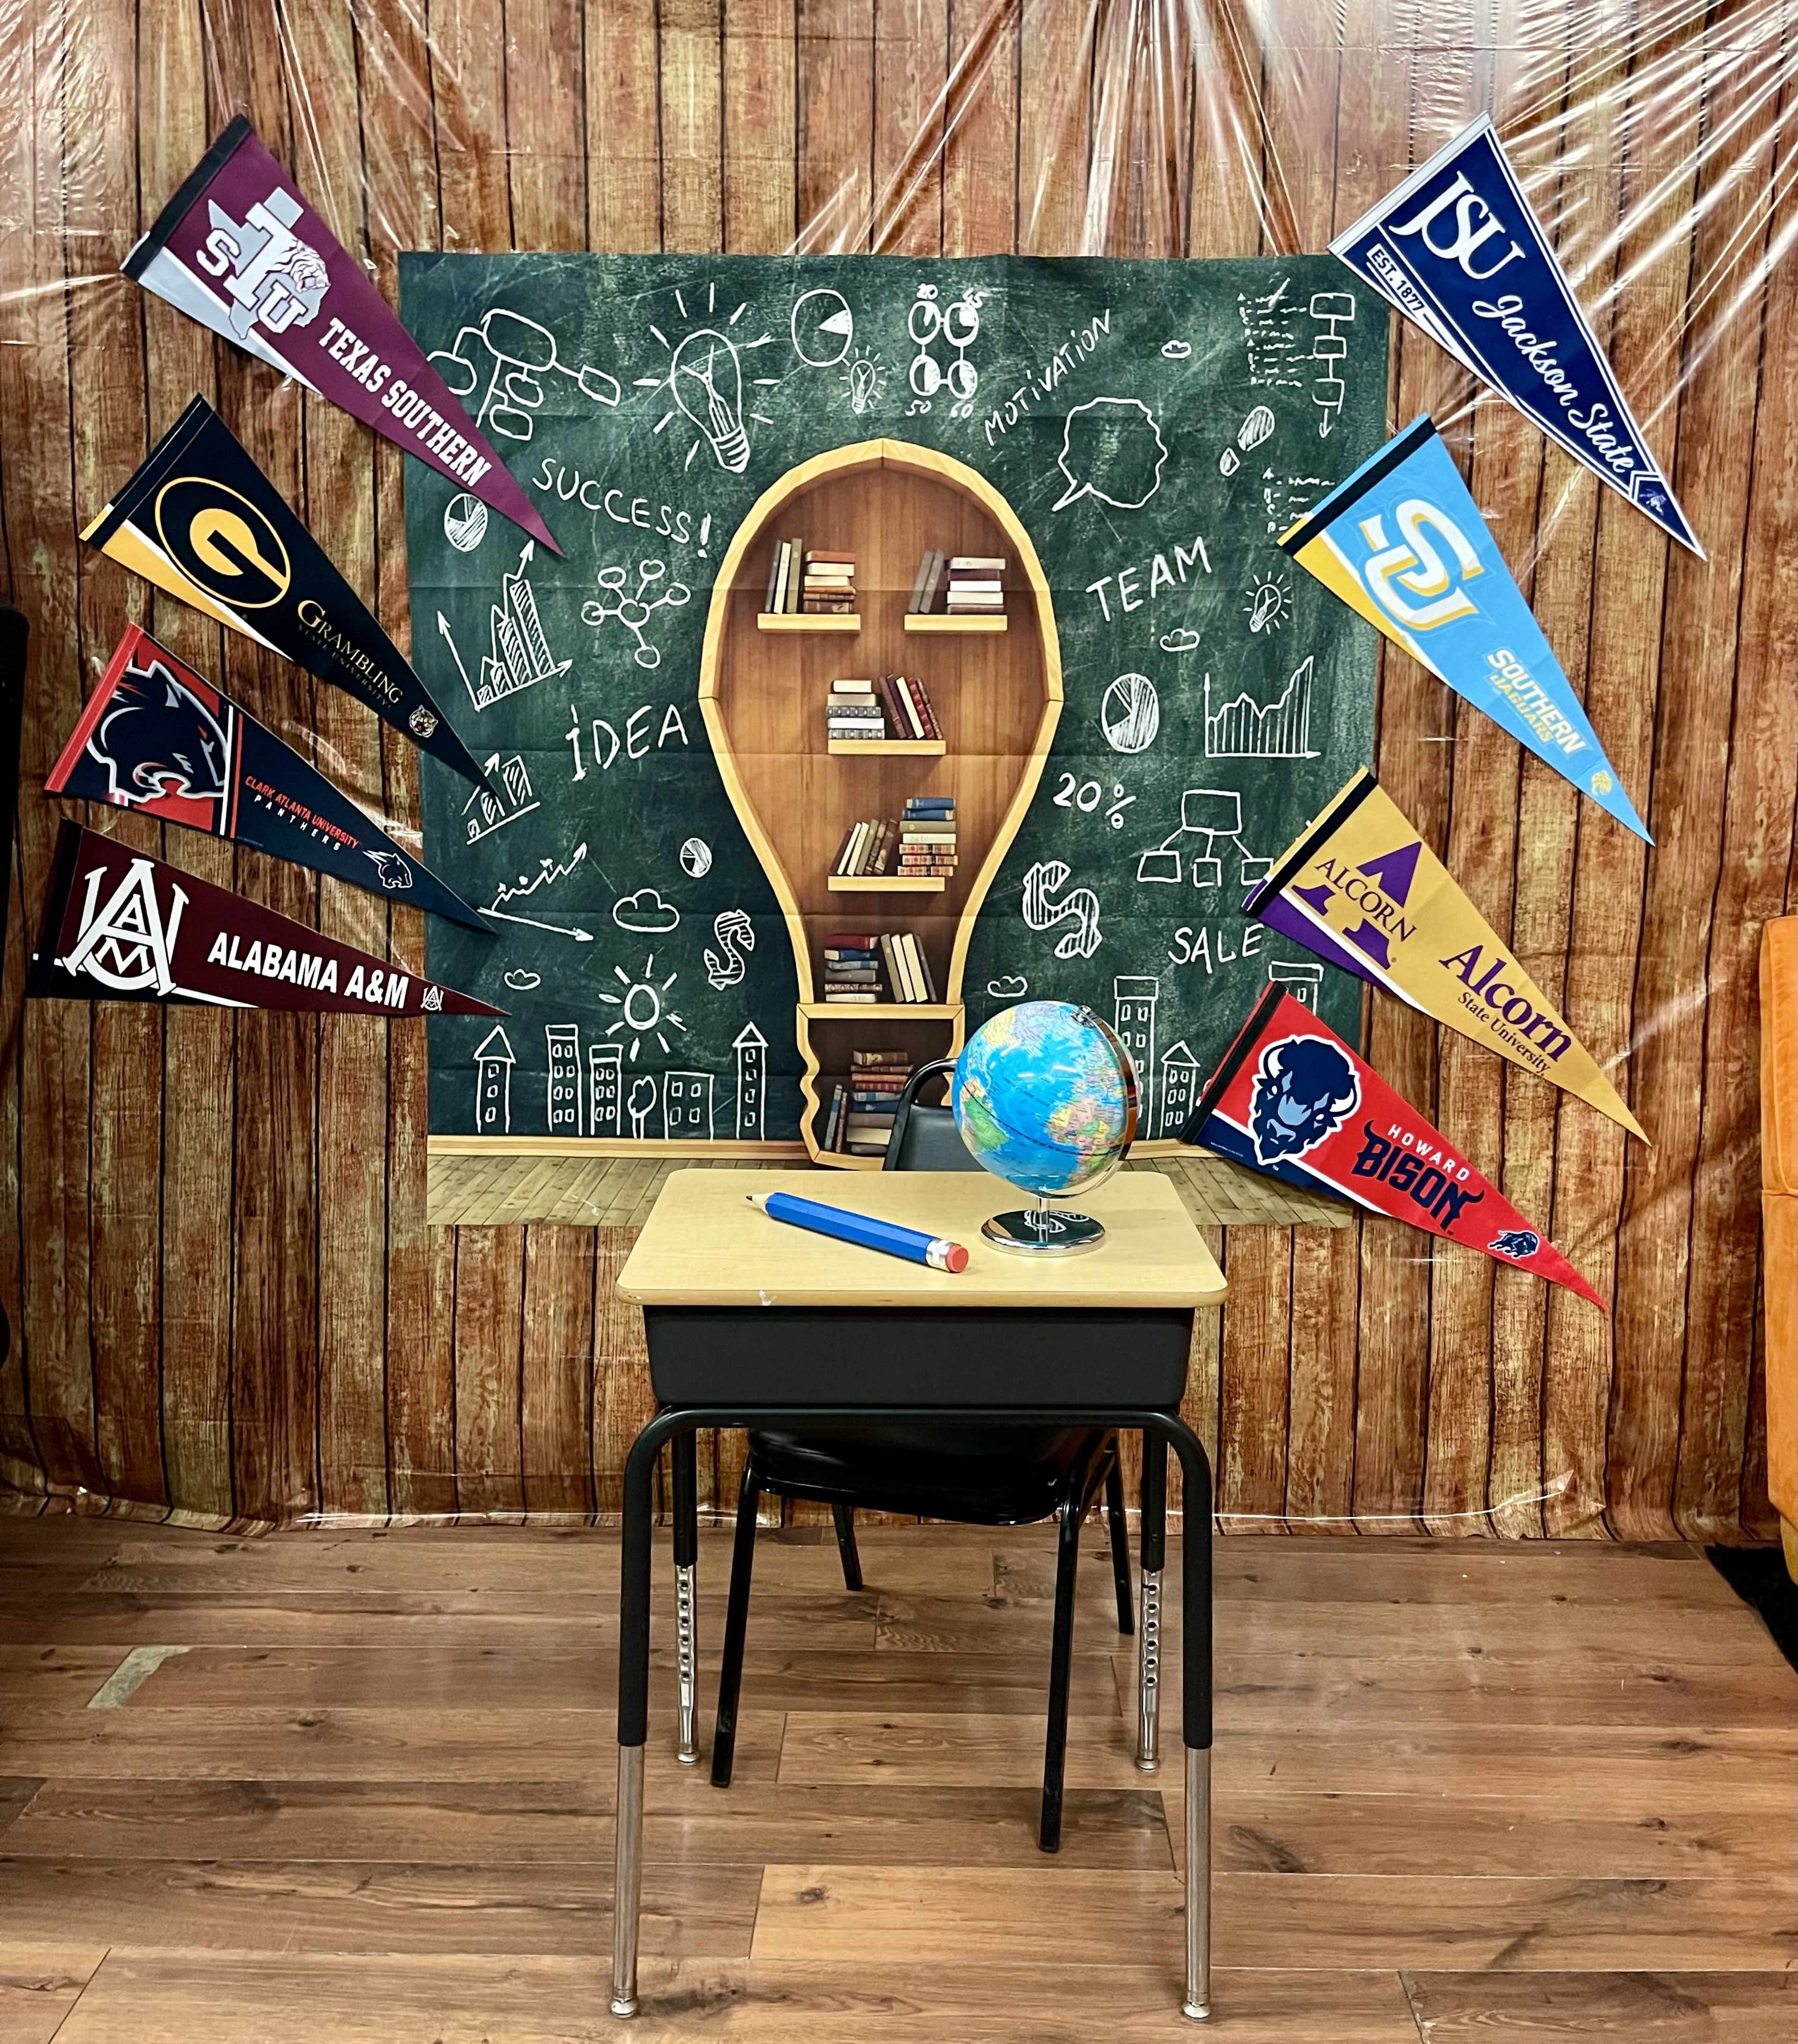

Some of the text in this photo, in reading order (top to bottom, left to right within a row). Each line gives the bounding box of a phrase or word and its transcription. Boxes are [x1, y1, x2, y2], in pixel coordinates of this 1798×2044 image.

[1388, 170, 1525, 280] JSU
[1371, 249, 1425, 311] EST. 1877
[318, 317, 492, 487] TEXAS SOUTHERN
[904, 399, 932, 417] 50
[950, 401, 974, 419] 60
[1473, 294, 1636, 473] Jackson State
[1085, 536, 1212, 622] TEAM
[1487, 649, 1586, 754] SOUTHERN
[1489, 674, 1552, 742] JAGUARS
[245, 776, 360, 849] CLARK ATLANTA UNIVERSITY
[254, 795, 341, 851] PANTHERS
[1053, 772, 1137, 829] 20%
[1314, 857, 1418, 943] ALCORN
[208, 932, 408, 1009] ALABAMA A&M
[1168, 923, 1264, 974] SALE
[1438, 945, 1572, 1063] Alcorn
[1458, 991, 1551, 1074] State University
[1351, 1120, 1485, 1232] BISON
[1387, 1124, 1470, 1181] HOWARD
